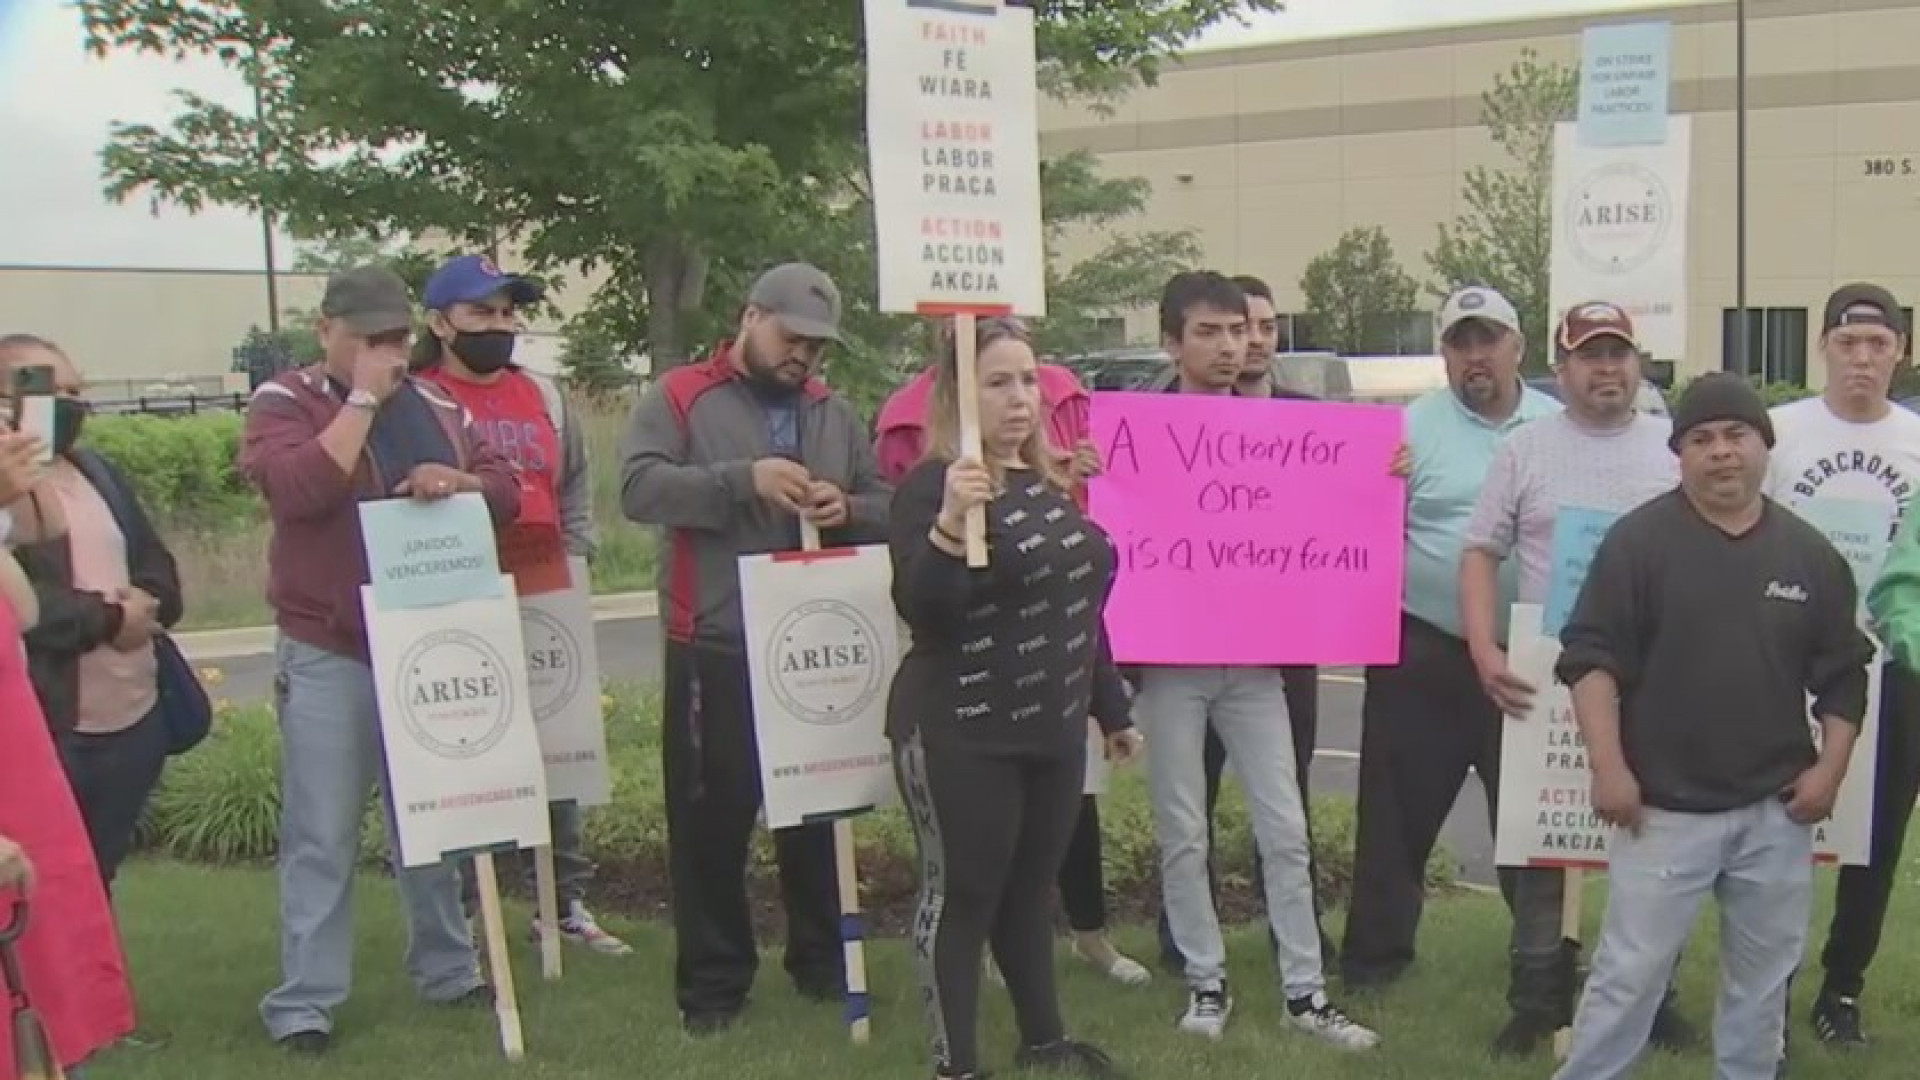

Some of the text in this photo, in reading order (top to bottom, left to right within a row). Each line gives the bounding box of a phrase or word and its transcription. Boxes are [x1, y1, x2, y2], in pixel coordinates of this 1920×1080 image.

[922, 21, 987, 44] FAITH
[919, 76, 992, 99] WIARA
[921, 121, 992, 141] LABOR
[922, 147, 993, 168] LABOR
[1864, 158, 1896, 176] 380
[923, 173, 997, 196] PRACA
[1577, 203, 1657, 227] ARISE
[921, 218, 1002, 239] ACTION
[931, 270, 999, 292] AKCJA
[1106, 415, 1139, 474] A
[1301, 430, 1348, 466] for
[1791, 449, 1911, 519] BERCROMBI
[783, 643, 867, 673] ARISE
[413, 674, 498, 706] ARISE
[1547, 731, 1584, 748] LAB
[1545, 752, 1585, 770] PRA
[1538, 786, 1586, 805] ACTI
[1542, 832, 1606, 852] AKCJA
